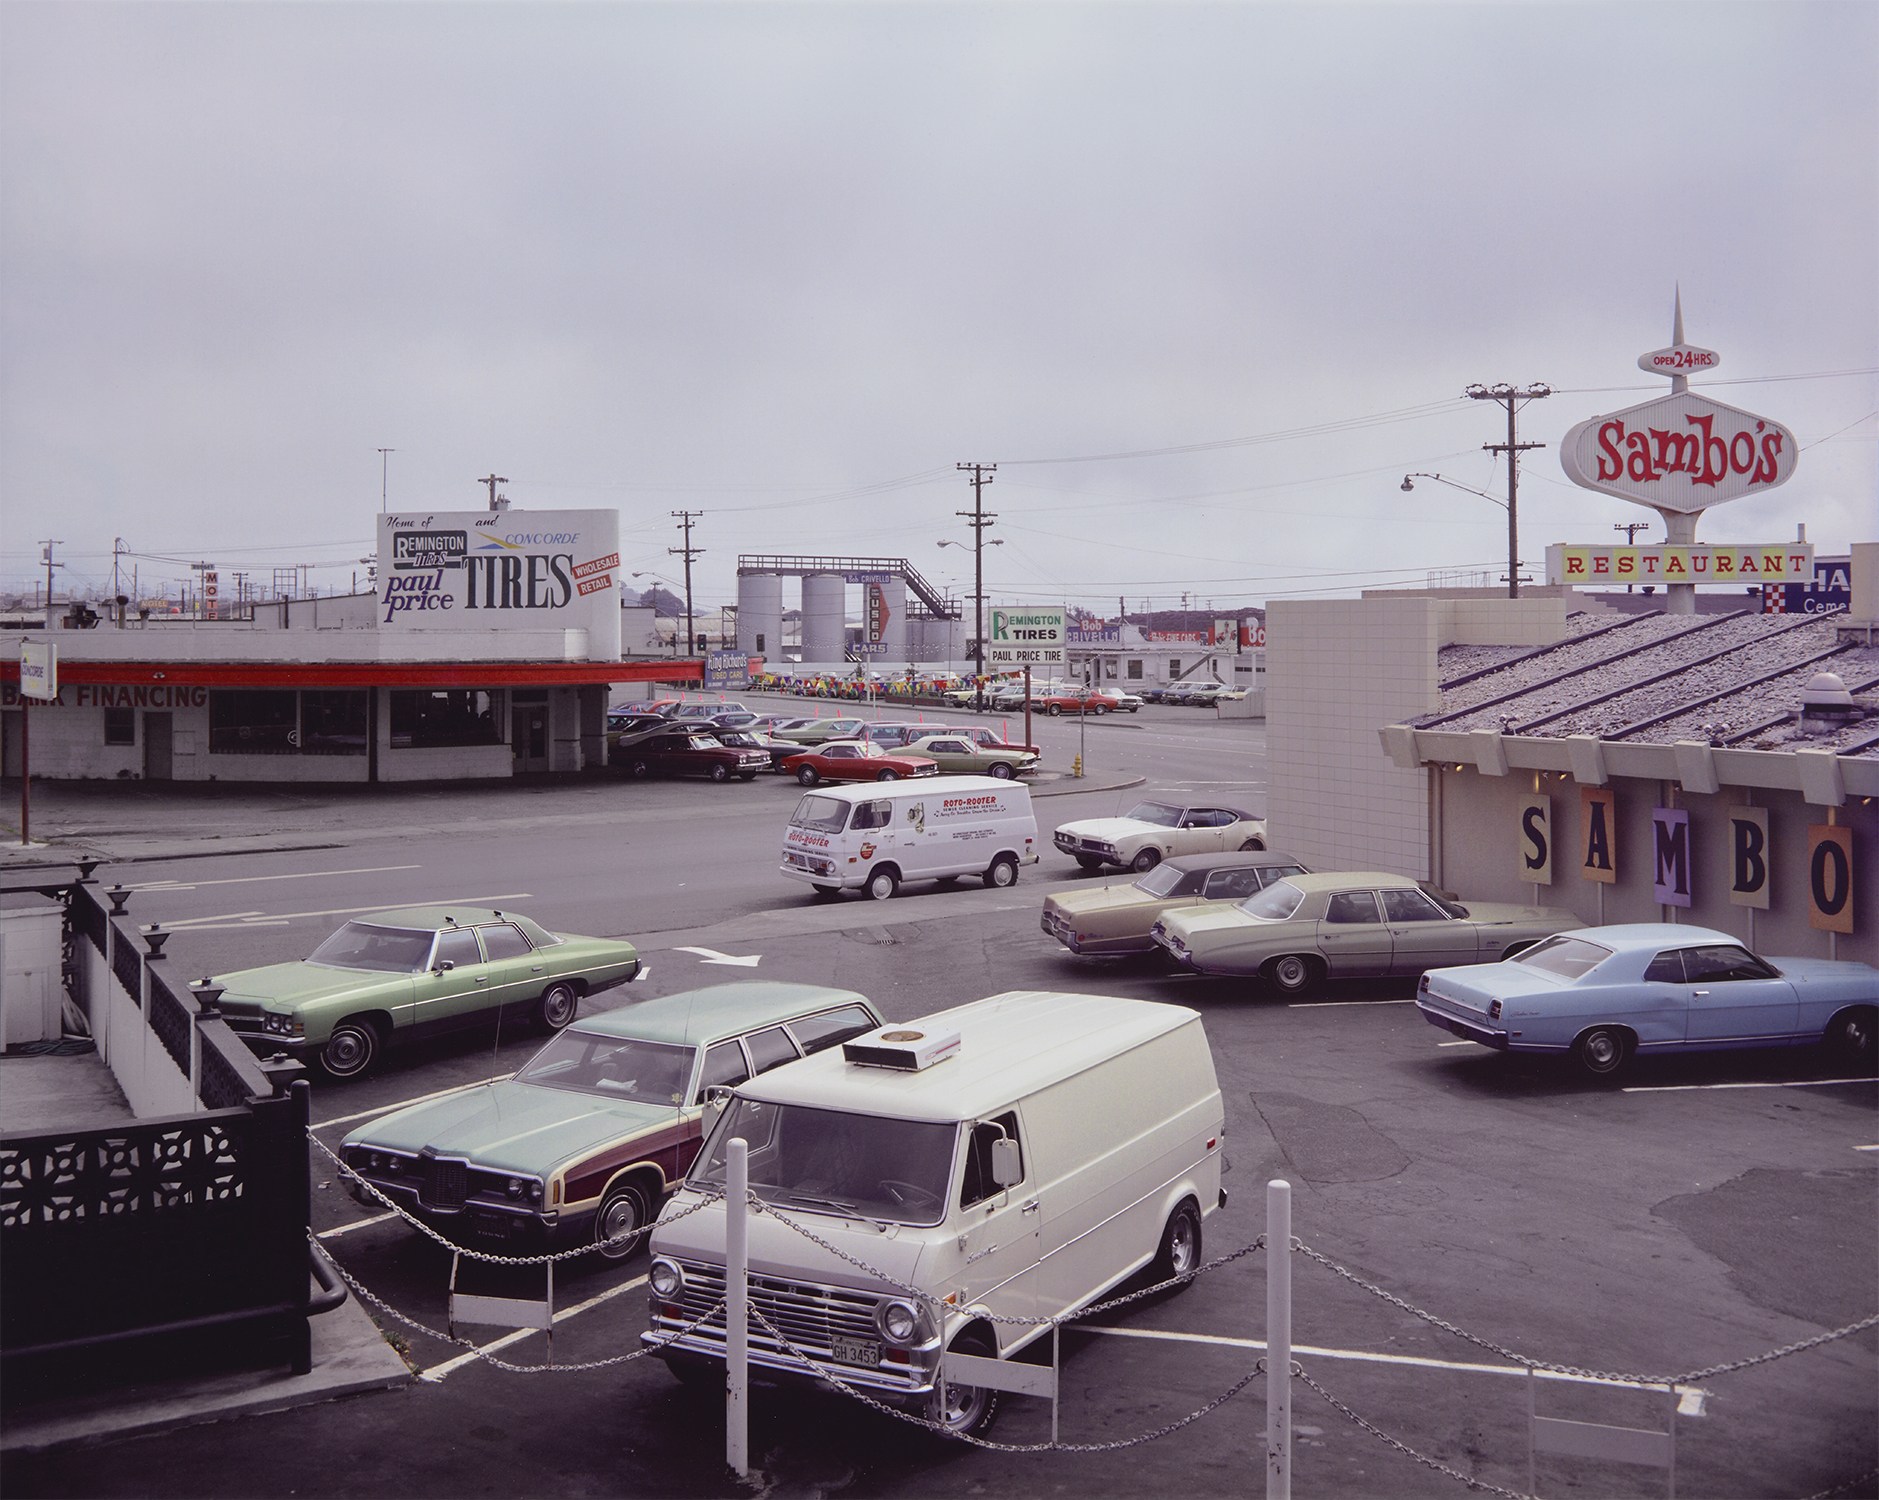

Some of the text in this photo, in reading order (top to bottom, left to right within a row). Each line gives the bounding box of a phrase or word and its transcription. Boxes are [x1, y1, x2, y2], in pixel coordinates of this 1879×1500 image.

[1653, 351, 1714, 368] OPEN 24 HRS.
[1597, 414, 1783, 488] Sambo's
[386, 516, 434, 529] Home of
[475, 515, 500, 527] and
[505, 533, 578, 545] CONCORDE
[396, 536, 464, 559] REMINGTON
[413, 551, 448, 567] TIRES
[575, 554, 619, 577] WHOLESALE
[1567, 555, 1805, 574] RESTAURANT
[382, 569, 444, 604] paul
[461, 554, 573, 609] TIRES
[580, 577, 610, 593] RETAIL
[848, 575, 890, 583] Bob CRIVELLO
[384, 591, 454, 623] price
[871, 600, 879, 640] USED
[993, 611, 1061, 640] REMINGTON
[1081, 619, 1102, 631] Bob
[1013, 629, 1057, 640] TIRES
[852, 644, 886, 653] CARS
[992, 650, 1062, 661] PAUL PRICE TIRE
[707, 653, 747, 671] King Richard's
[21, 664, 44, 678] CONCORDE
[712, 671, 743, 680] USED CARS
[77, 685, 207, 708] FINANCING
[943, 796, 997, 808] ROTO-ROOTER
[788, 832, 830, 848] ROTO-ROOTER
[833, 1345, 877, 1365] GH 3453
